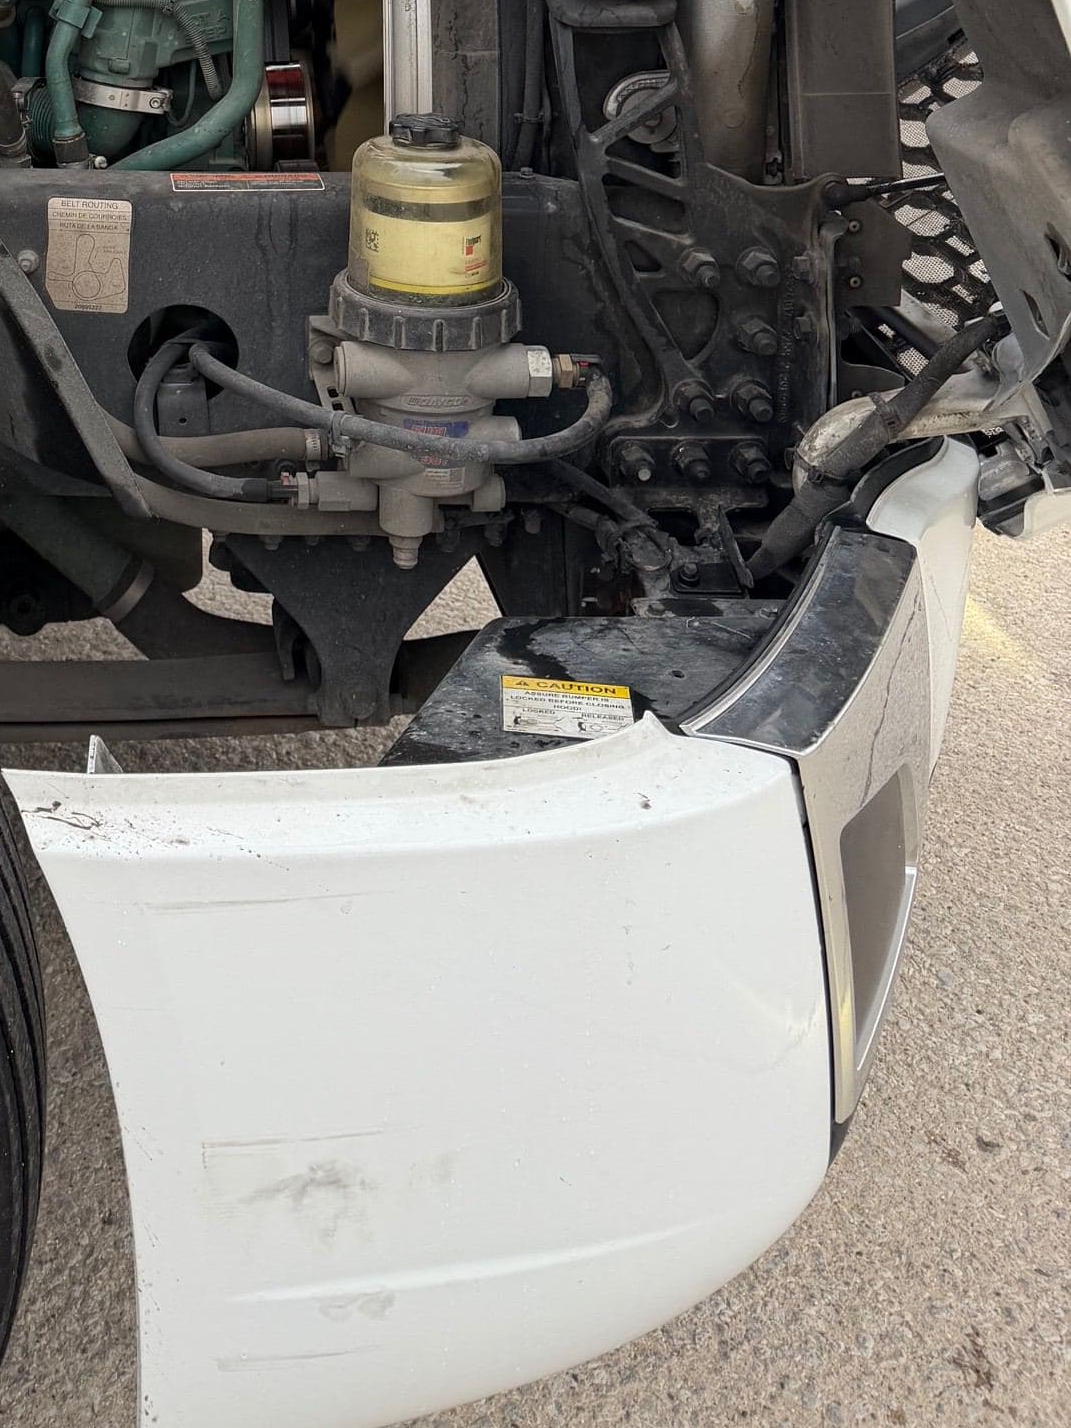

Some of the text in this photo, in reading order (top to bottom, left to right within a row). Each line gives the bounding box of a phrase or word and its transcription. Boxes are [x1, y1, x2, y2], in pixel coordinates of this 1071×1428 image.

[82, 201, 119, 210] ROUTING
[537, 681, 616, 694] CAUTION
[561, 694, 599, 702] BUMPER
[548, 698, 585, 706] BEFORE
[585, 702, 625, 710] CLOSING
[581, 713, 624, 721] RELEASED
